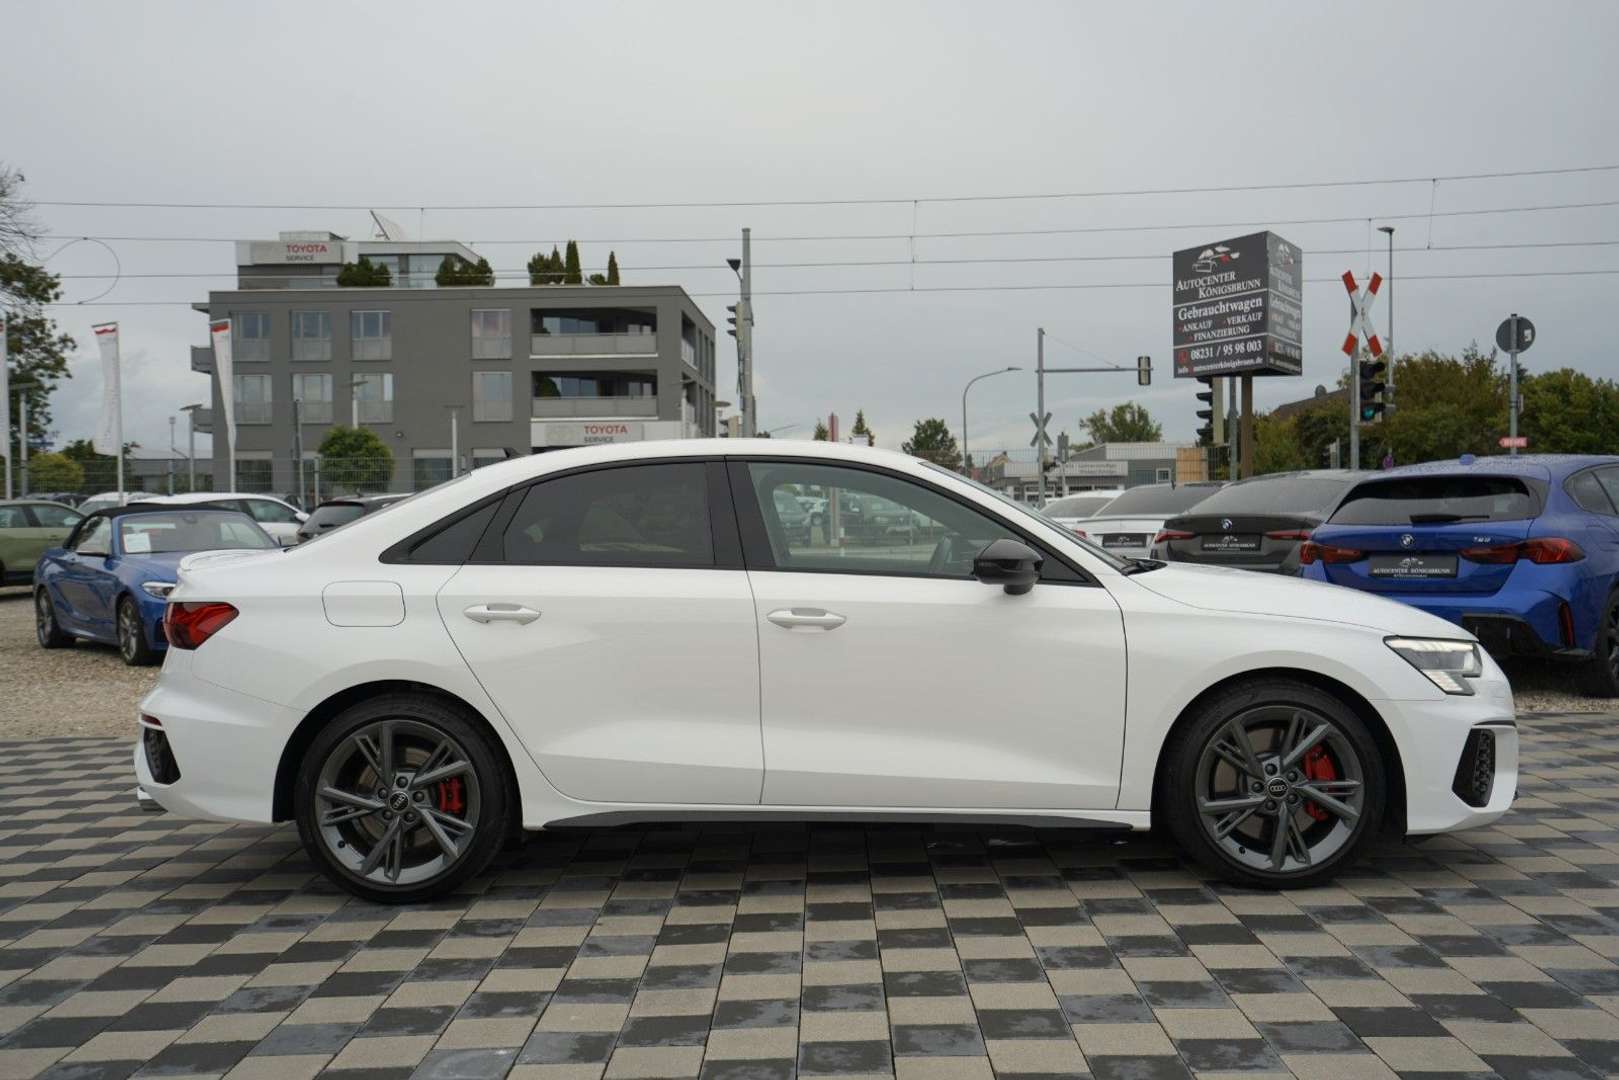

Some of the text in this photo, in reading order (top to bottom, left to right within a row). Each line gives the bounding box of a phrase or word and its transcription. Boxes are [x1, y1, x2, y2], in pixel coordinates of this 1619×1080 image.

[287, 244, 327, 253] TOYOTA
[1176, 271, 1236, 291] AUTOCENTER
[1199, 279, 1261, 299] KÖNIGSBRUNN
[1178, 297, 1262, 321] Gebrauchtwagen
[1182, 320, 1213, 332] ANKAUF
[1227, 312, 1263, 325] VERKAUF
[1193, 325, 1250, 341] FINANZIERUNG
[1190, 347, 1214, 360] 08231
[1223, 344, 1233, 356] 95
[1235, 342, 1245, 353] 98
[1246, 340, 1262, 352] 003
[584, 425, 628, 434] TOYOTA
